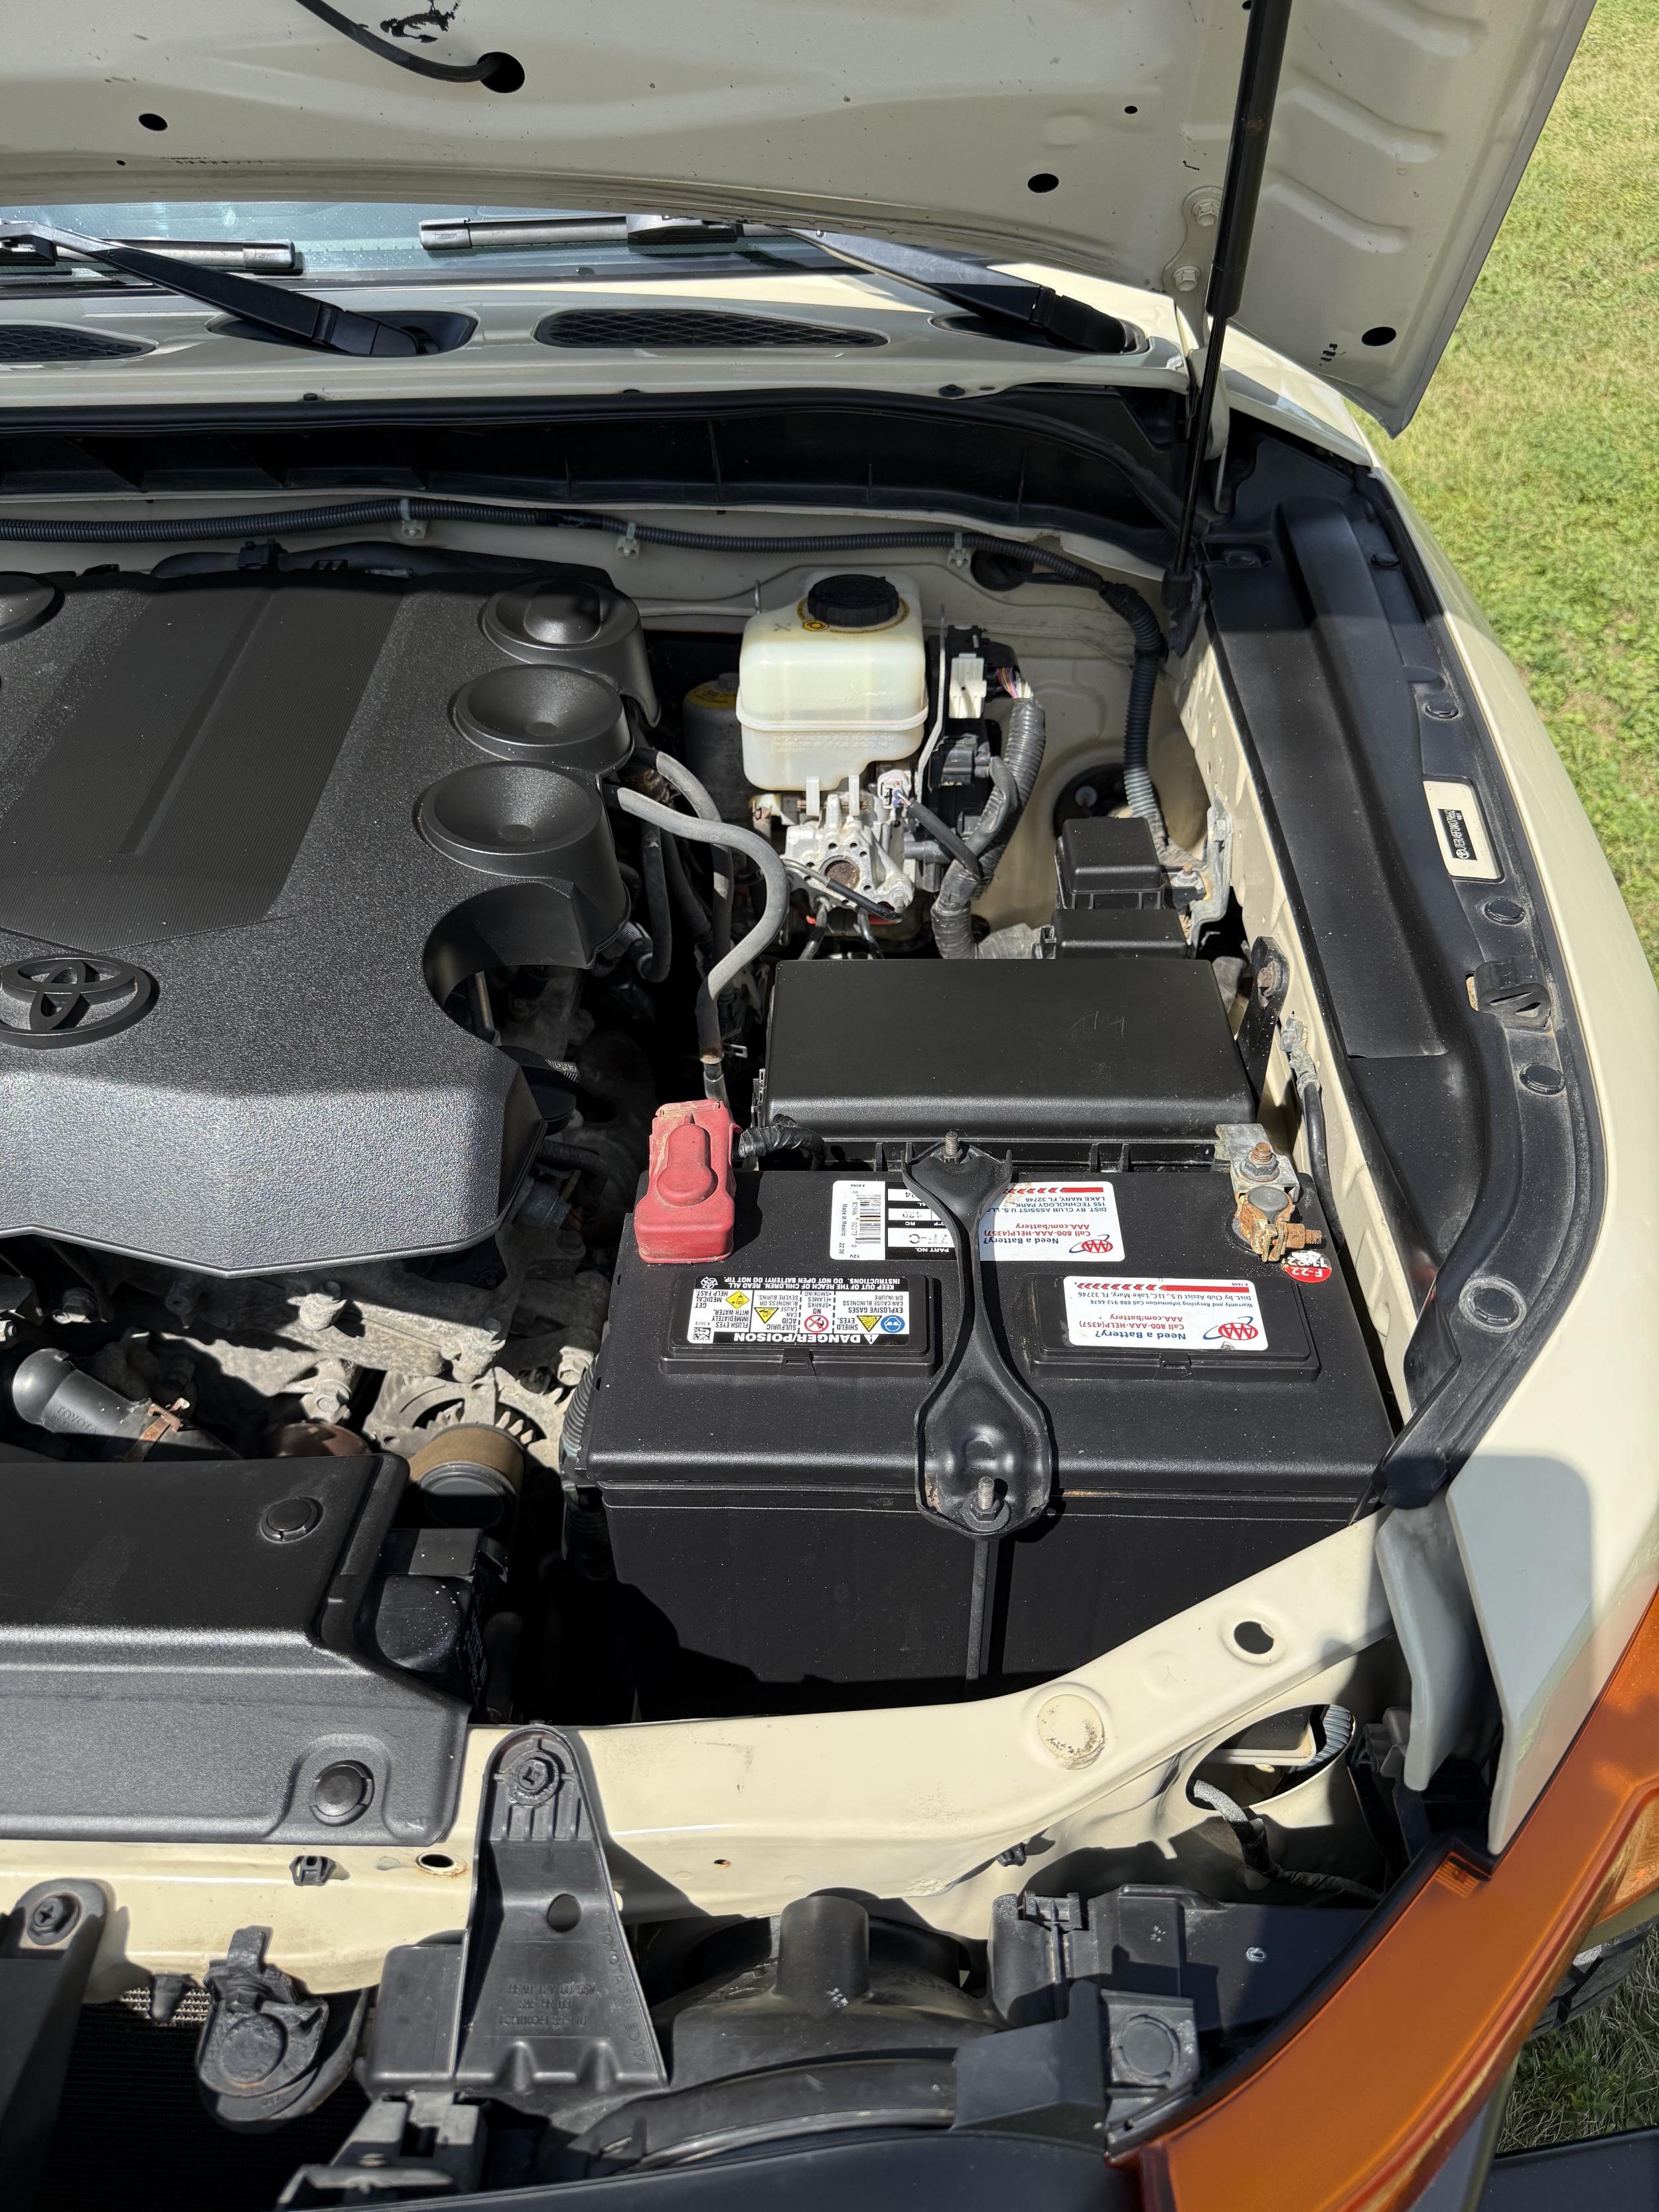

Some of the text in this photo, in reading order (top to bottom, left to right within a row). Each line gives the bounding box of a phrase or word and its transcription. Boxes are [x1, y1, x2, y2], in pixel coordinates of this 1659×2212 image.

[909, 1234, 952, 1244] 7F-C
[1291, 1267, 1323, 1277] F-22
[1079, 1321, 1165, 1329] 800-AAA-HELP(4357)
[734, 1333, 861, 1343] DANGER/POISON
[56, 1404, 98, 1434] TOYOTA
[601, 1925, 625, 1984] TOYOTA
[519, 1999, 536, 2009] SAE
